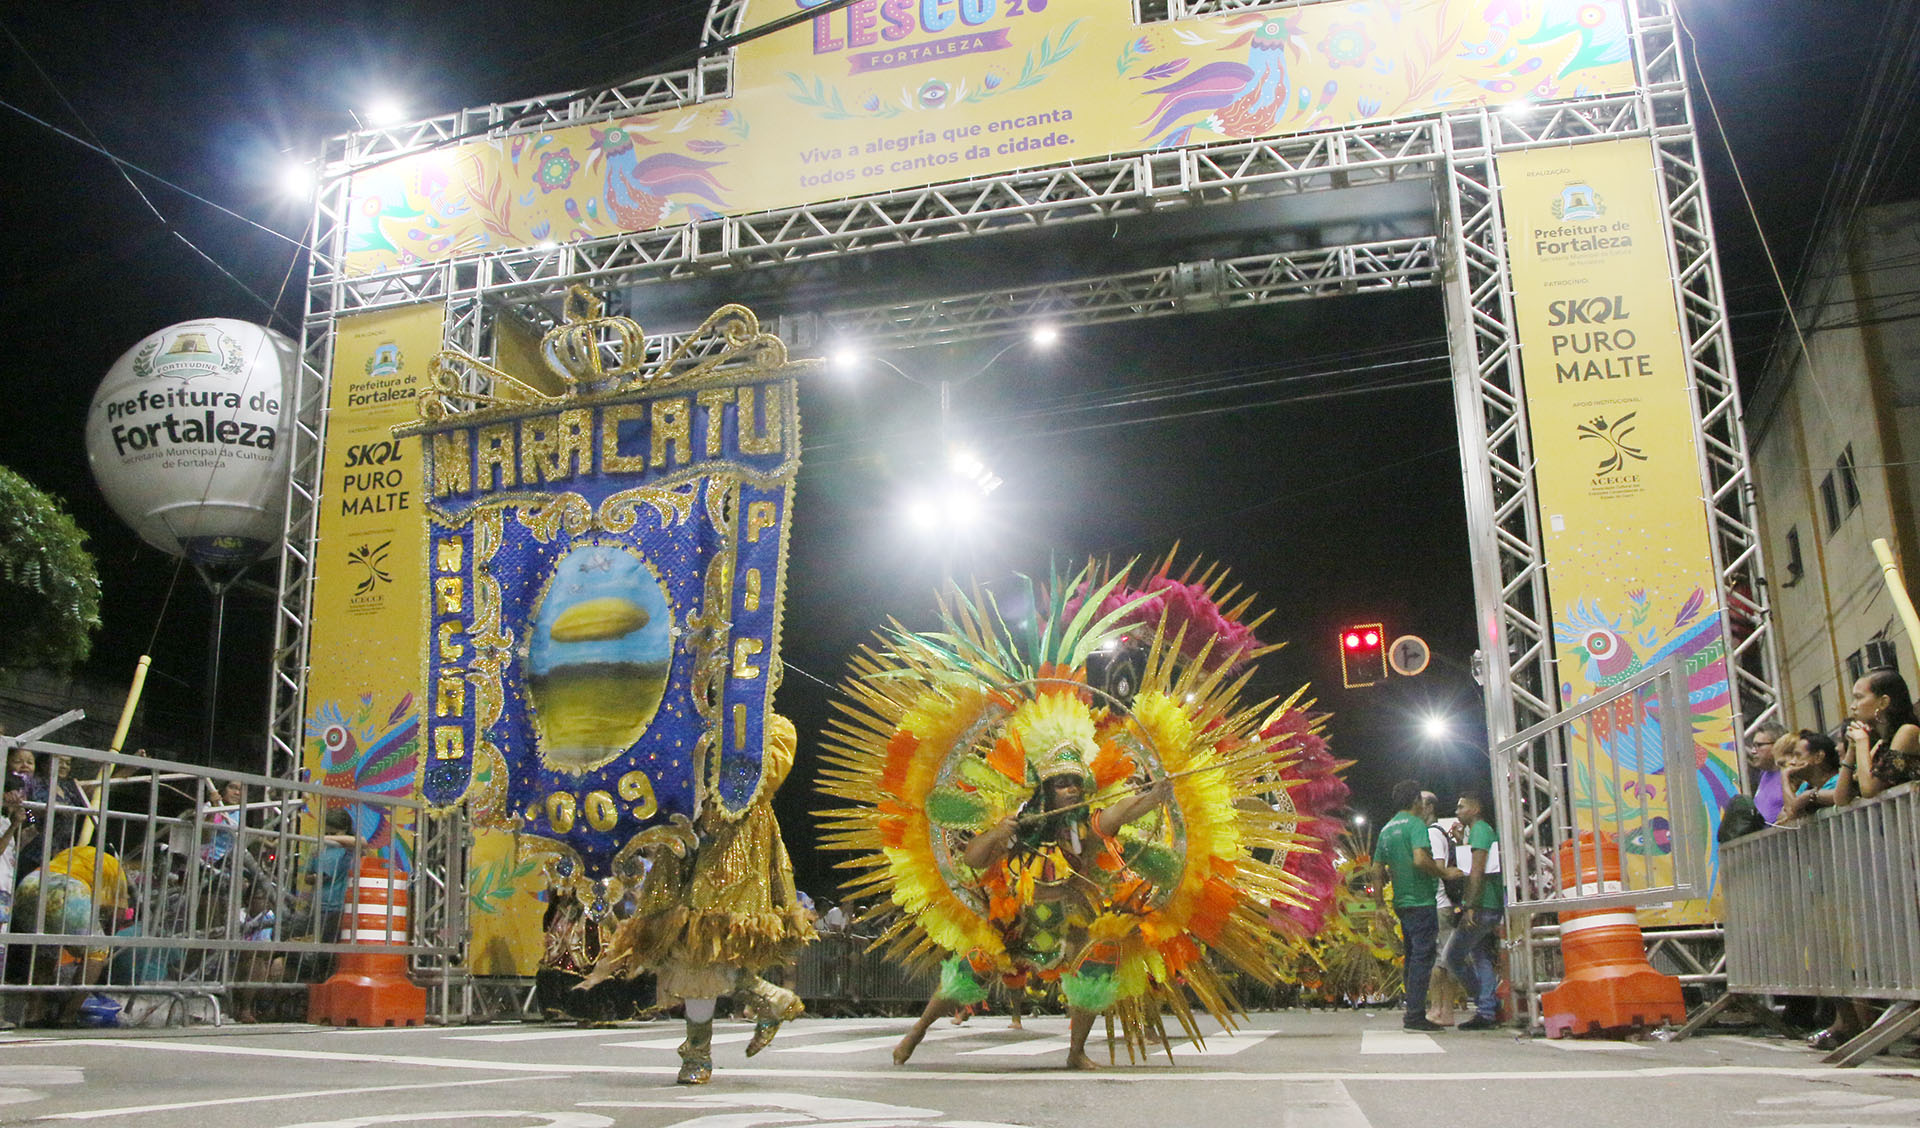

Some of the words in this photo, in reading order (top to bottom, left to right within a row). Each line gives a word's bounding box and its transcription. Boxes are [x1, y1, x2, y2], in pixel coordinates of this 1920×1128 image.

[871, 38, 984, 66] FORTALEZA
[801, 149, 842, 165] Viva
[849, 146, 860, 157] a
[866, 130, 937, 157] alegria
[943, 124, 982, 145] que
[988, 107, 1074, 134] encanta
[800, 169, 855, 188] todos
[862, 163, 885, 176] os
[892, 150, 959, 170] cantos
[965, 143, 991, 162] da
[997, 134, 1075, 156] cidade.
[1534, 225, 1606, 239] Prefeitura
[1612, 220, 1630, 232] de
[1536, 234, 1632, 256] Fortaleza
[1548, 295, 1630, 326] SKOL
[1552, 329, 1636, 356] PURO
[157, 363, 218, 373] FORTITUDINE
[1556, 355, 1653, 384] MALTE
[348, 386, 416, 407] Fortaleza
[349, 378, 401, 393] Prefeitura
[404, 375, 417, 384] de
[107, 388, 241, 422] Prefeitura
[249, 391, 280, 415] de
[111, 411, 277, 456] Fortaleza
[432, 387, 782, 497] MARACATU
[122, 450, 164, 465] Secretaria
[166, 447, 218, 458] Municipal
[219, 449, 233, 457] da
[236, 450, 274, 463] Cultura
[162, 459, 175, 469] de
[177, 458, 226, 468] Fortaleza
[344, 440, 403, 468] SKOL
[343, 470, 403, 493] PURO
[1591, 475, 1640, 486] ACECCE
[341, 491, 410, 517] MALTE
[732, 501, 777, 750] PICI
